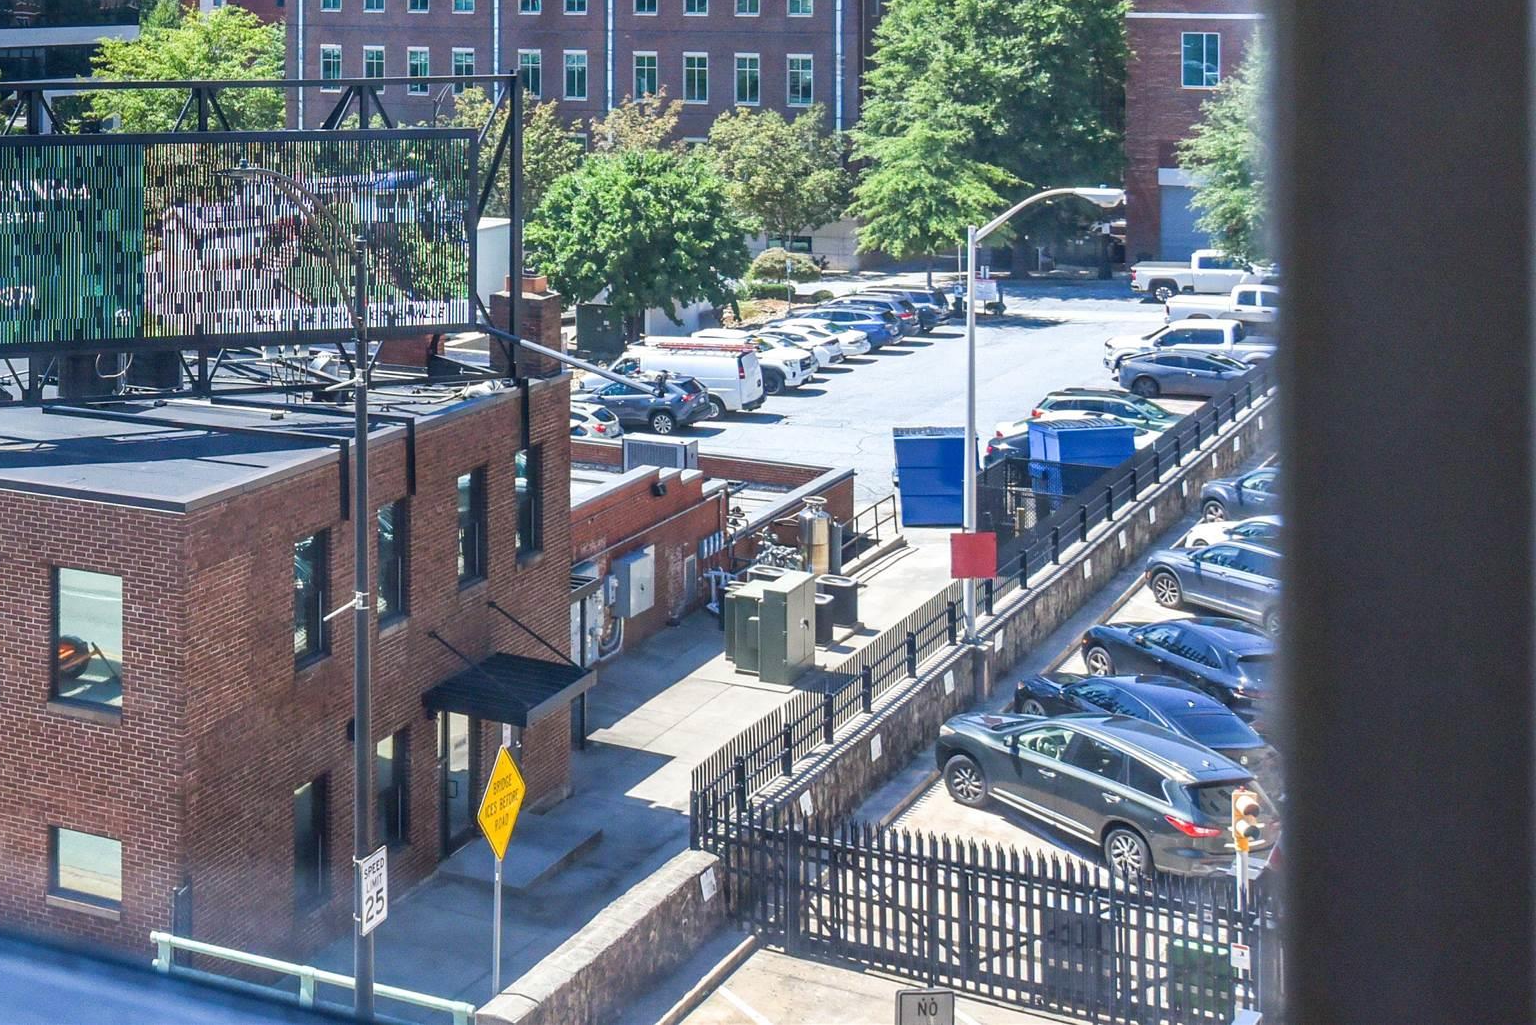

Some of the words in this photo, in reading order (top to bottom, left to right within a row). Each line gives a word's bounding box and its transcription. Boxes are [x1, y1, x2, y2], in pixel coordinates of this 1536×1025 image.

[493, 773, 513, 795] BRIDGE
[485, 801, 498, 819] ICES
[500, 788, 519, 811] BEFORE
[495, 813, 509, 832] ROAD
[364, 857, 385, 880] SPEED
[366, 873, 383, 894] LIMIT
[365, 887, 385, 924] 25
[917, 1001, 939, 1017] NO
